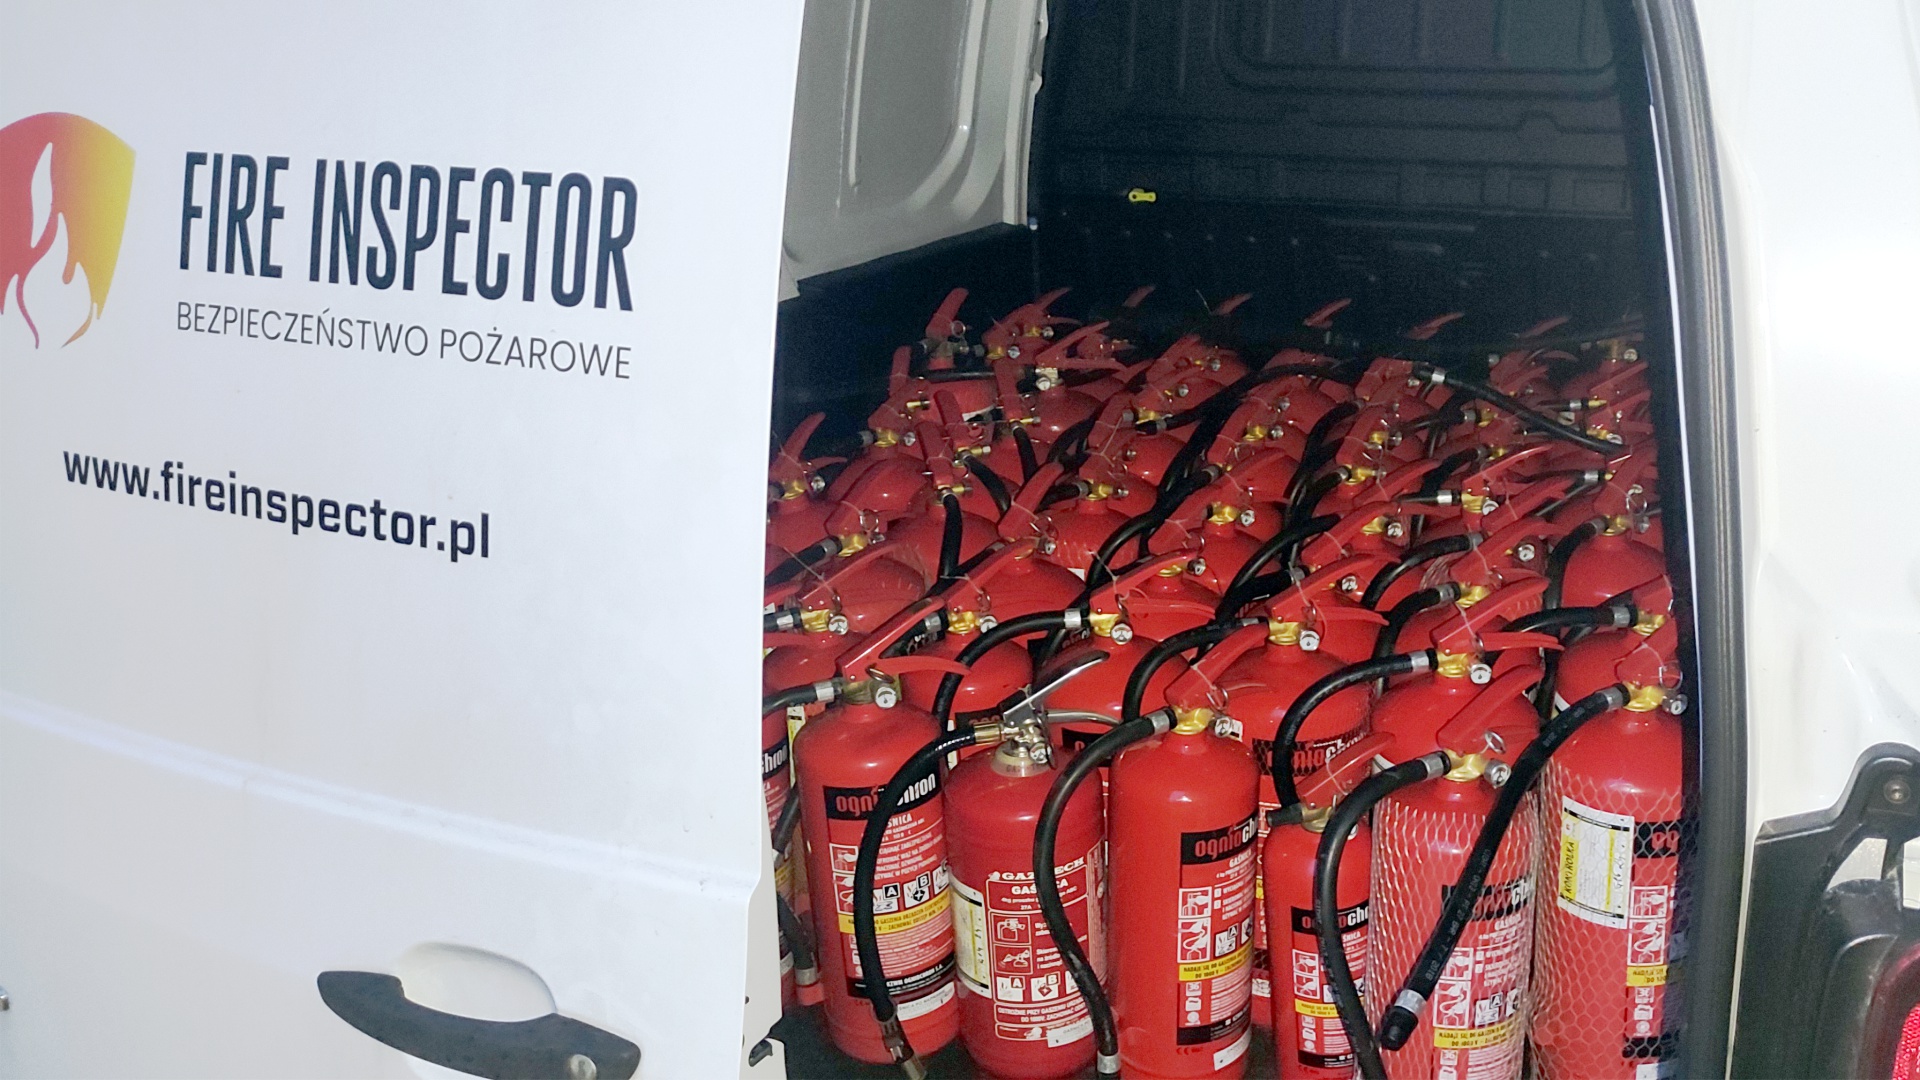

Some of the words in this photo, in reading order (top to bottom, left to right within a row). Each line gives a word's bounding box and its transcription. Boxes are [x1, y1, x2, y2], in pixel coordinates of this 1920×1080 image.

[180, 152, 291, 279] FIRE
[309, 158, 639, 312] INSPECTOR
[177, 302, 429, 357] BEZPIECZEŃSTWO
[439, 327, 632, 380] POŻAROWE
[63, 451, 491, 562] www.fireinspector.pl
[919, 875, 928, 886] B
[887, 887, 897, 897] A
[1229, 926, 1238, 936] A
[1012, 977, 1022, 988] A
[1047, 974, 1058, 985] B
[1491, 995, 1501, 1006] A
